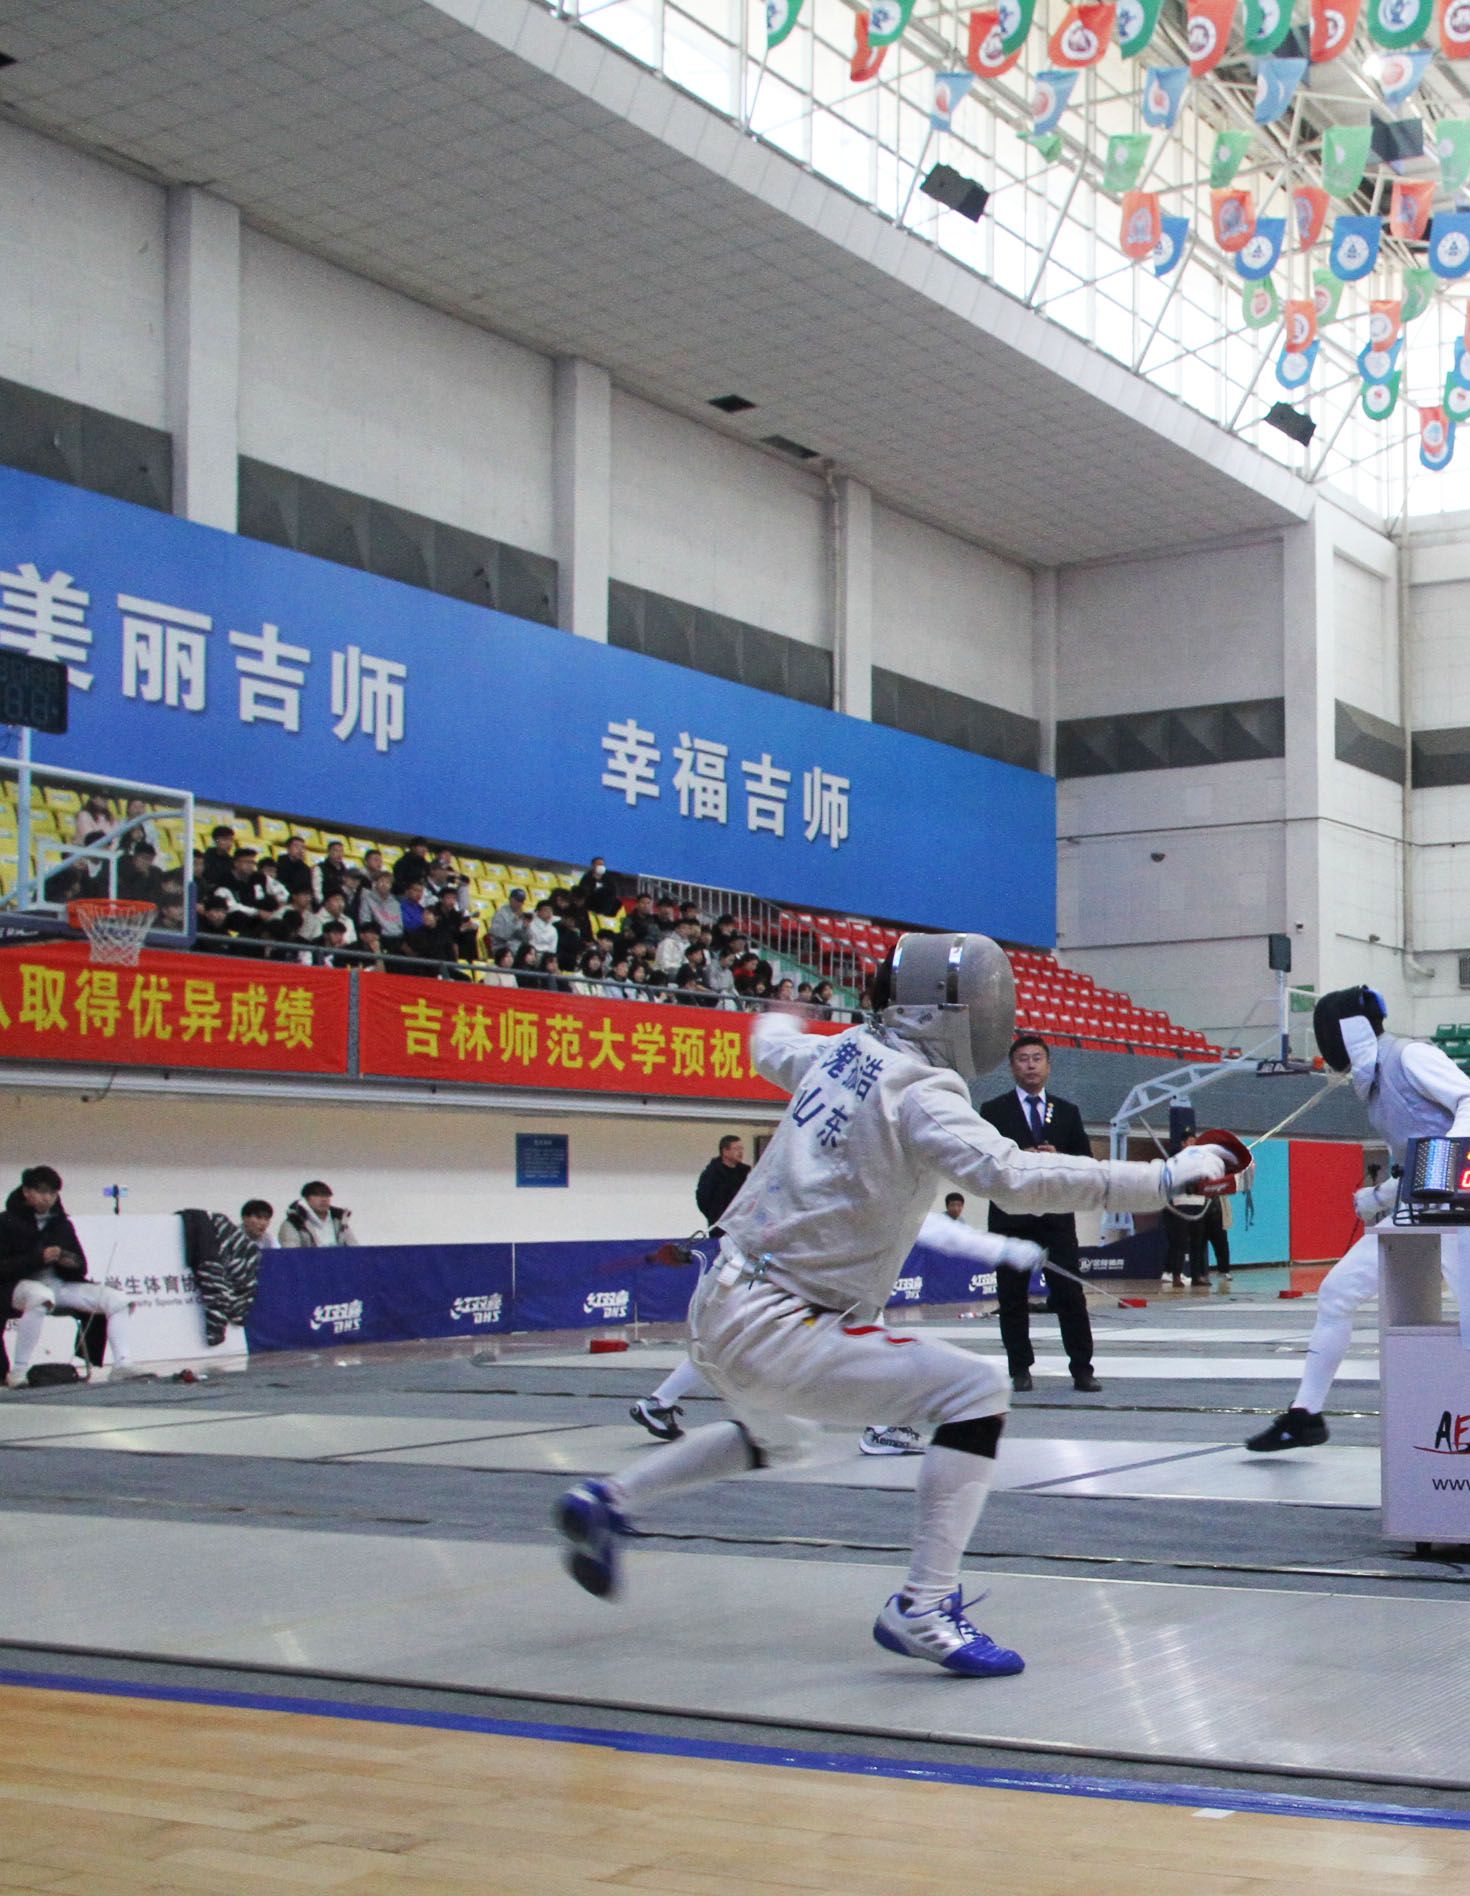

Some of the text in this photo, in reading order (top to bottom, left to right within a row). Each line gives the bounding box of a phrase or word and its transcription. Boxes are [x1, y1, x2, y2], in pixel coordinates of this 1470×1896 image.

[0, 562, 407, 752] 美丽吉师
[601, 718, 850, 849] 幸福吉师
[0, 963, 315, 1050] 取得优异成绩
[391, 998, 760, 1081] 吉林师范大学预祝
[792, 1086, 849, 1147] 山东
[334, 1319, 362, 1334] DHS
[473, 1310, 502, 1324] DHS
